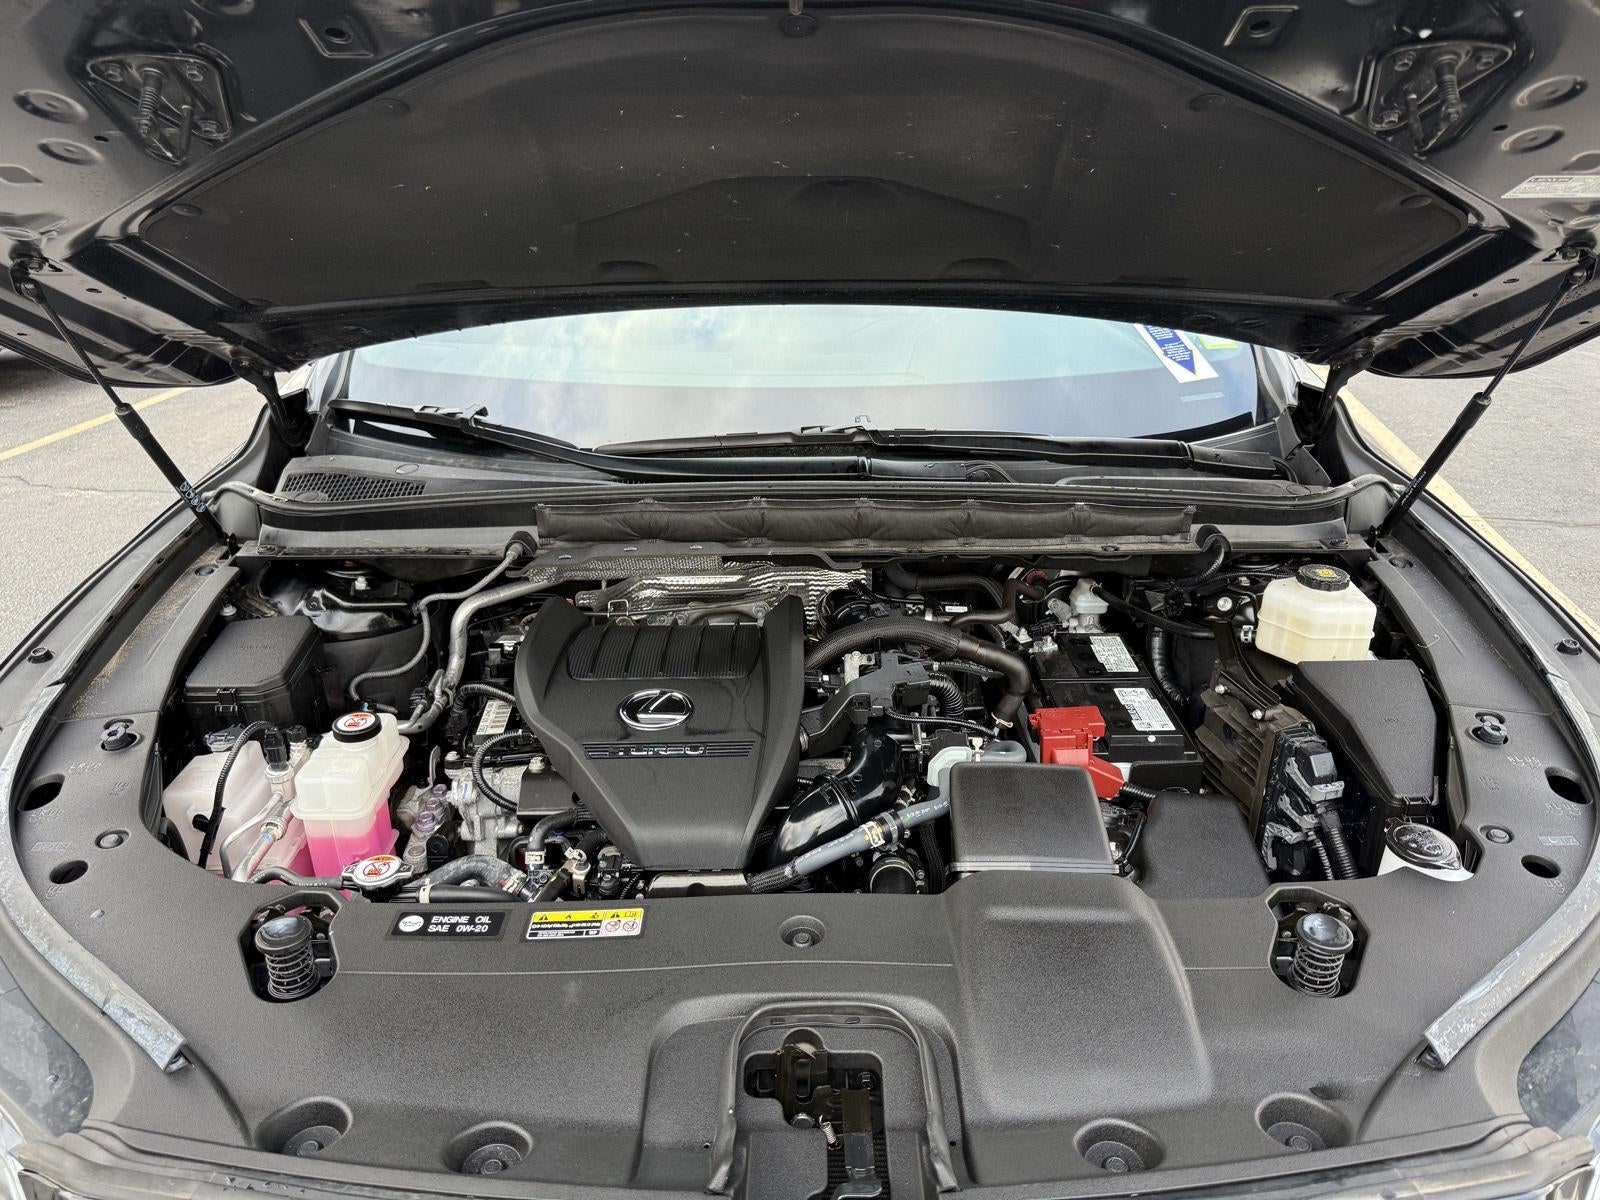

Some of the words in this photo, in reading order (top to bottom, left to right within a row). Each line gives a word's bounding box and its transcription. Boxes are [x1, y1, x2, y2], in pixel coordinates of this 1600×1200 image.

[616, 744, 703, 757] TURBO
[431, 915, 470, 923] ENGINE
[475, 915, 492, 923] OIL
[428, 924, 450, 932] SAE
[456, 924, 489, 933] 0W-20
